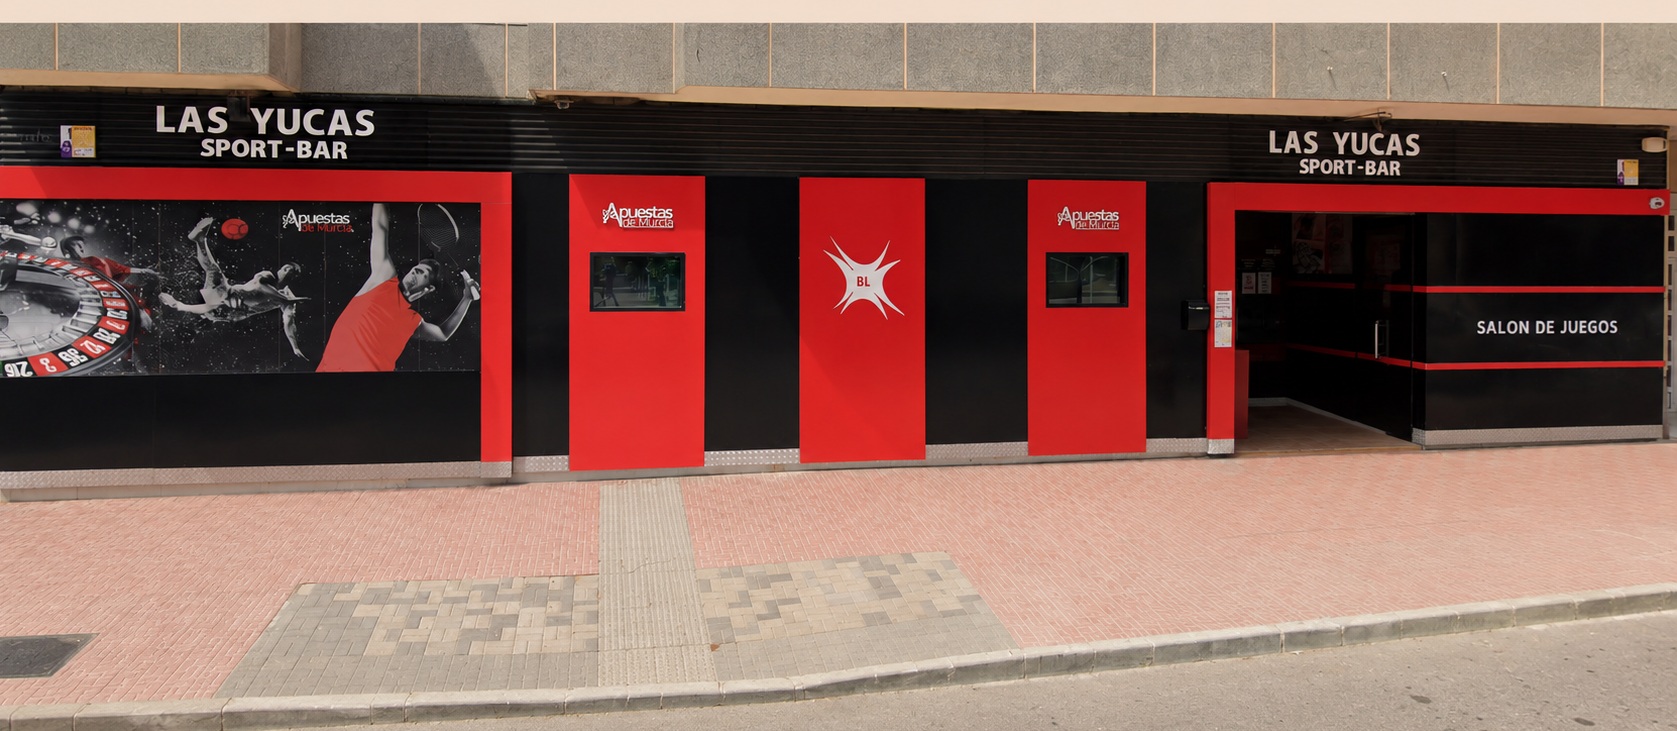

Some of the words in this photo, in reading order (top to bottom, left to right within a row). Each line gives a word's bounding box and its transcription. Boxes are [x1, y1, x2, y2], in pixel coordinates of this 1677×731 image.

[156, 105, 228, 134] LAS
[250, 108, 375, 137] YUCAS
[200, 138, 348, 160] SPORT-BAR
[1269, 130, 1319, 154] LAS
[1332, 131, 1420, 156] YUCAS
[1299, 158, 1401, 176] SPORT-BAR
[282, 208, 350, 231] Apuestas
[602, 202, 673, 227] Apuestas
[622, 218, 636, 228] de
[638, 217, 673, 228] Murcia
[1057, 206, 1119, 229] Apuestas
[857, 276, 871, 287] BL
[1477, 320, 1530, 335] SALON
[1535, 320, 1555, 335] DE
[1560, 320, 1618, 335] JUEGOS
